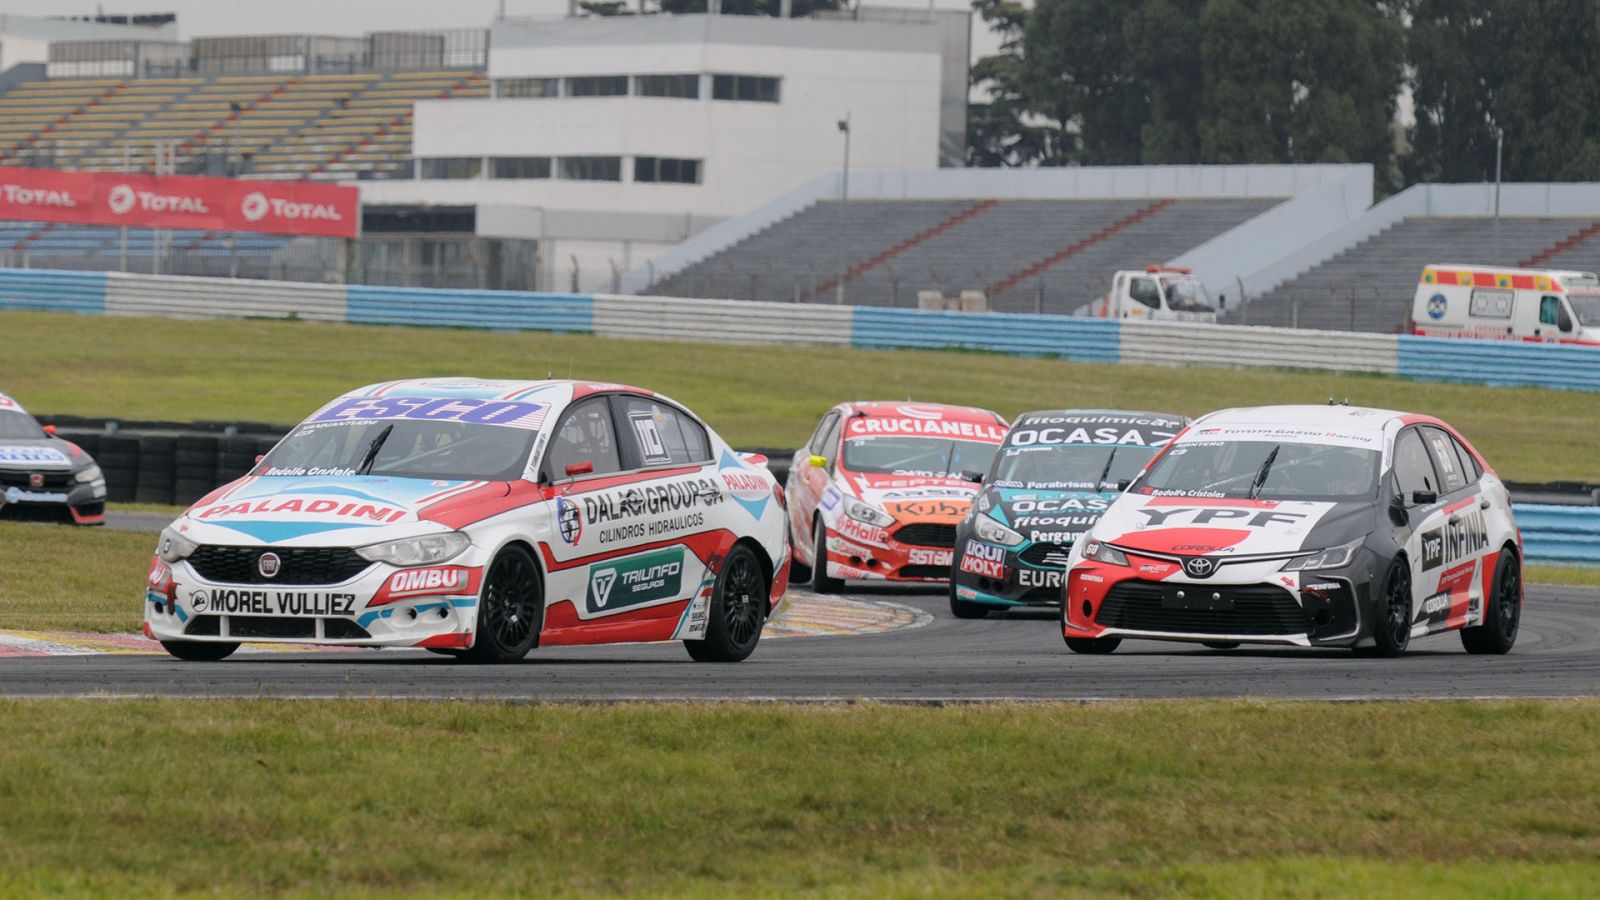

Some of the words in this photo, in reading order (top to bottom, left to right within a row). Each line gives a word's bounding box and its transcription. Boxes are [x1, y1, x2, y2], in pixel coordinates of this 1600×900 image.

[2, 185, 77, 207] TOTAL
[136, 191, 209, 214] TOTAL
[271, 198, 343, 221] TOTAL
[634, 419, 665, 456] 110
[1010, 426, 1146, 446] OCASA
[1323, 431, 1372, 442] Racing
[720, 472, 771, 492] PALADINI
[1026, 480, 1095, 490] Parabrisas
[1151, 488, 1186, 497] Rodolfo
[1186, 489, 1226, 499] Cristales
[200, 498, 409, 523] PALADINI
[1136, 507, 1308, 528] YPF
[600, 522, 646, 544] CILINDROS
[648, 511, 704, 536] HIDRAULICOS
[1424, 537, 1441, 561] YPF
[1443, 509, 1489, 564] INFINIA
[966, 541, 1004, 562] LIQUI
[1085, 542, 1099, 555] 60
[1171, 544, 1236, 553] COROLLA
[621, 561, 681, 585] TRIUNFO
[963, 555, 1000, 577] MOLY
[389, 569, 458, 593] OMBU
[631, 579, 665, 592] SEGUROS
[211, 589, 274, 613] MOREL
[276, 592, 356, 616] VULLIEZ
